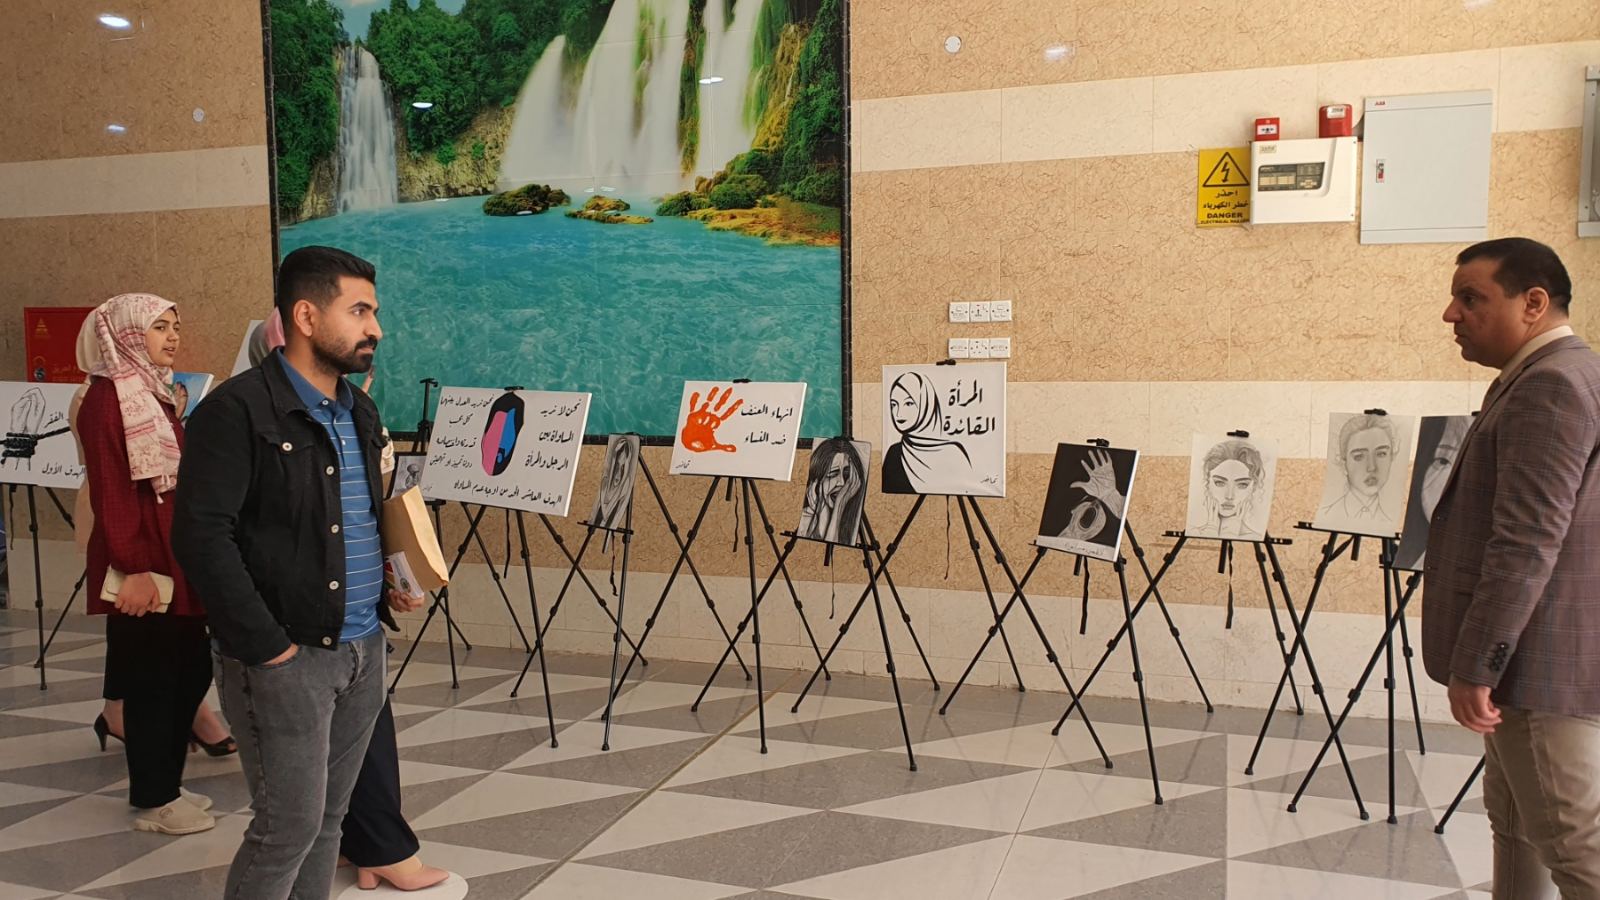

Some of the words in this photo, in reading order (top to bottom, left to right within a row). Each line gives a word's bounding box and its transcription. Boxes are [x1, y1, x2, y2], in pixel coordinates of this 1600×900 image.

[1216, 189, 1238, 198] احذر
[1203, 201, 1231, 210] الكهرباء
[1232, 199, 1249, 210] خطر
[948, 379, 983, 407] المرأة
[455, 396, 471, 407] العدل
[482, 393, 495, 408] نحن
[540, 404, 558, 418] نريد
[557, 404, 567, 416] لا
[565, 398, 582, 417] نحن
[740, 403, 769, 417] العنف
[943, 415, 996, 436] القائدة
[538, 431, 552, 442] بين
[550, 430, 575, 444] المساواة
[745, 431, 770, 444] النساء
[771, 434, 787, 446] ضد
[546, 456, 569, 471] الرجل
[65, 464, 87, 479] الهدف
[507, 485, 520, 498] الحد
[520, 488, 542, 501] العاشر
[543, 492, 563, 508] الهدف
